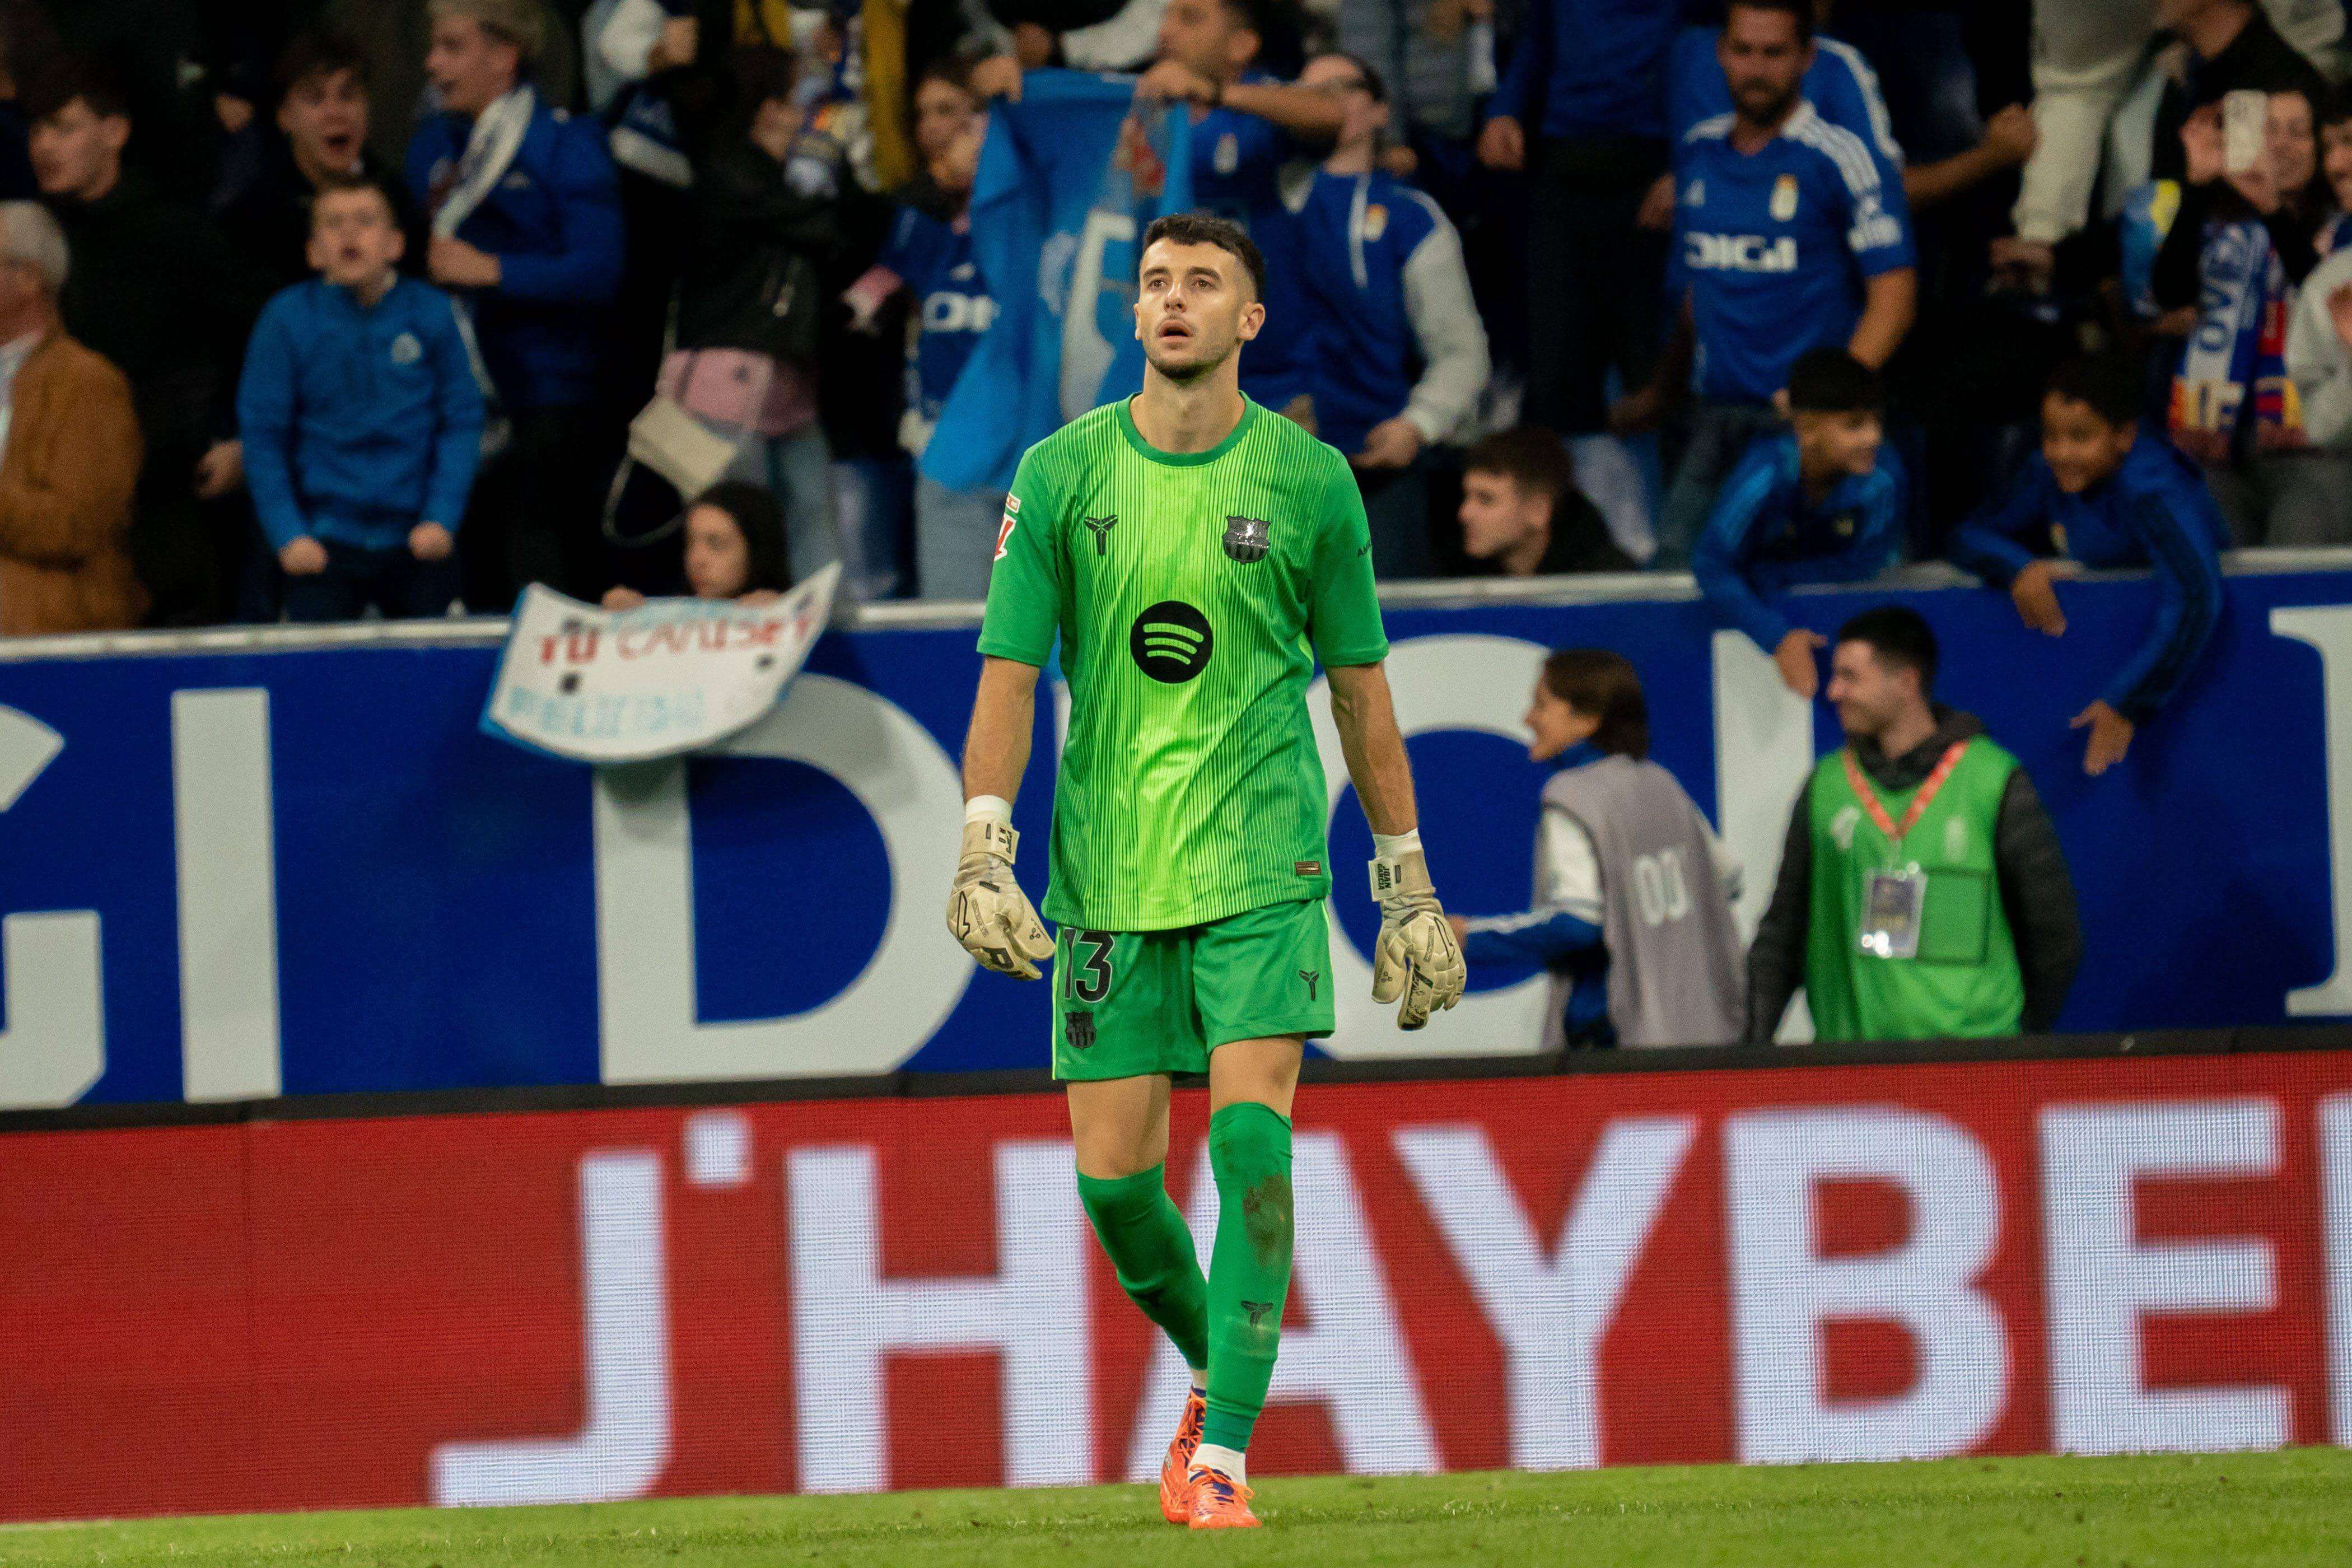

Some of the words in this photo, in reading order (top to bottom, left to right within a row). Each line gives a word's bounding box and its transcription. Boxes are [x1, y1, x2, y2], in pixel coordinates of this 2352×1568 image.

[591, 628, 1816, 1086] DGI
[1064, 927, 1116, 1003] 13
[1383, 866, 1392, 889] JOAN
[430, 1089, 2352, 1509] J'HAYBE
